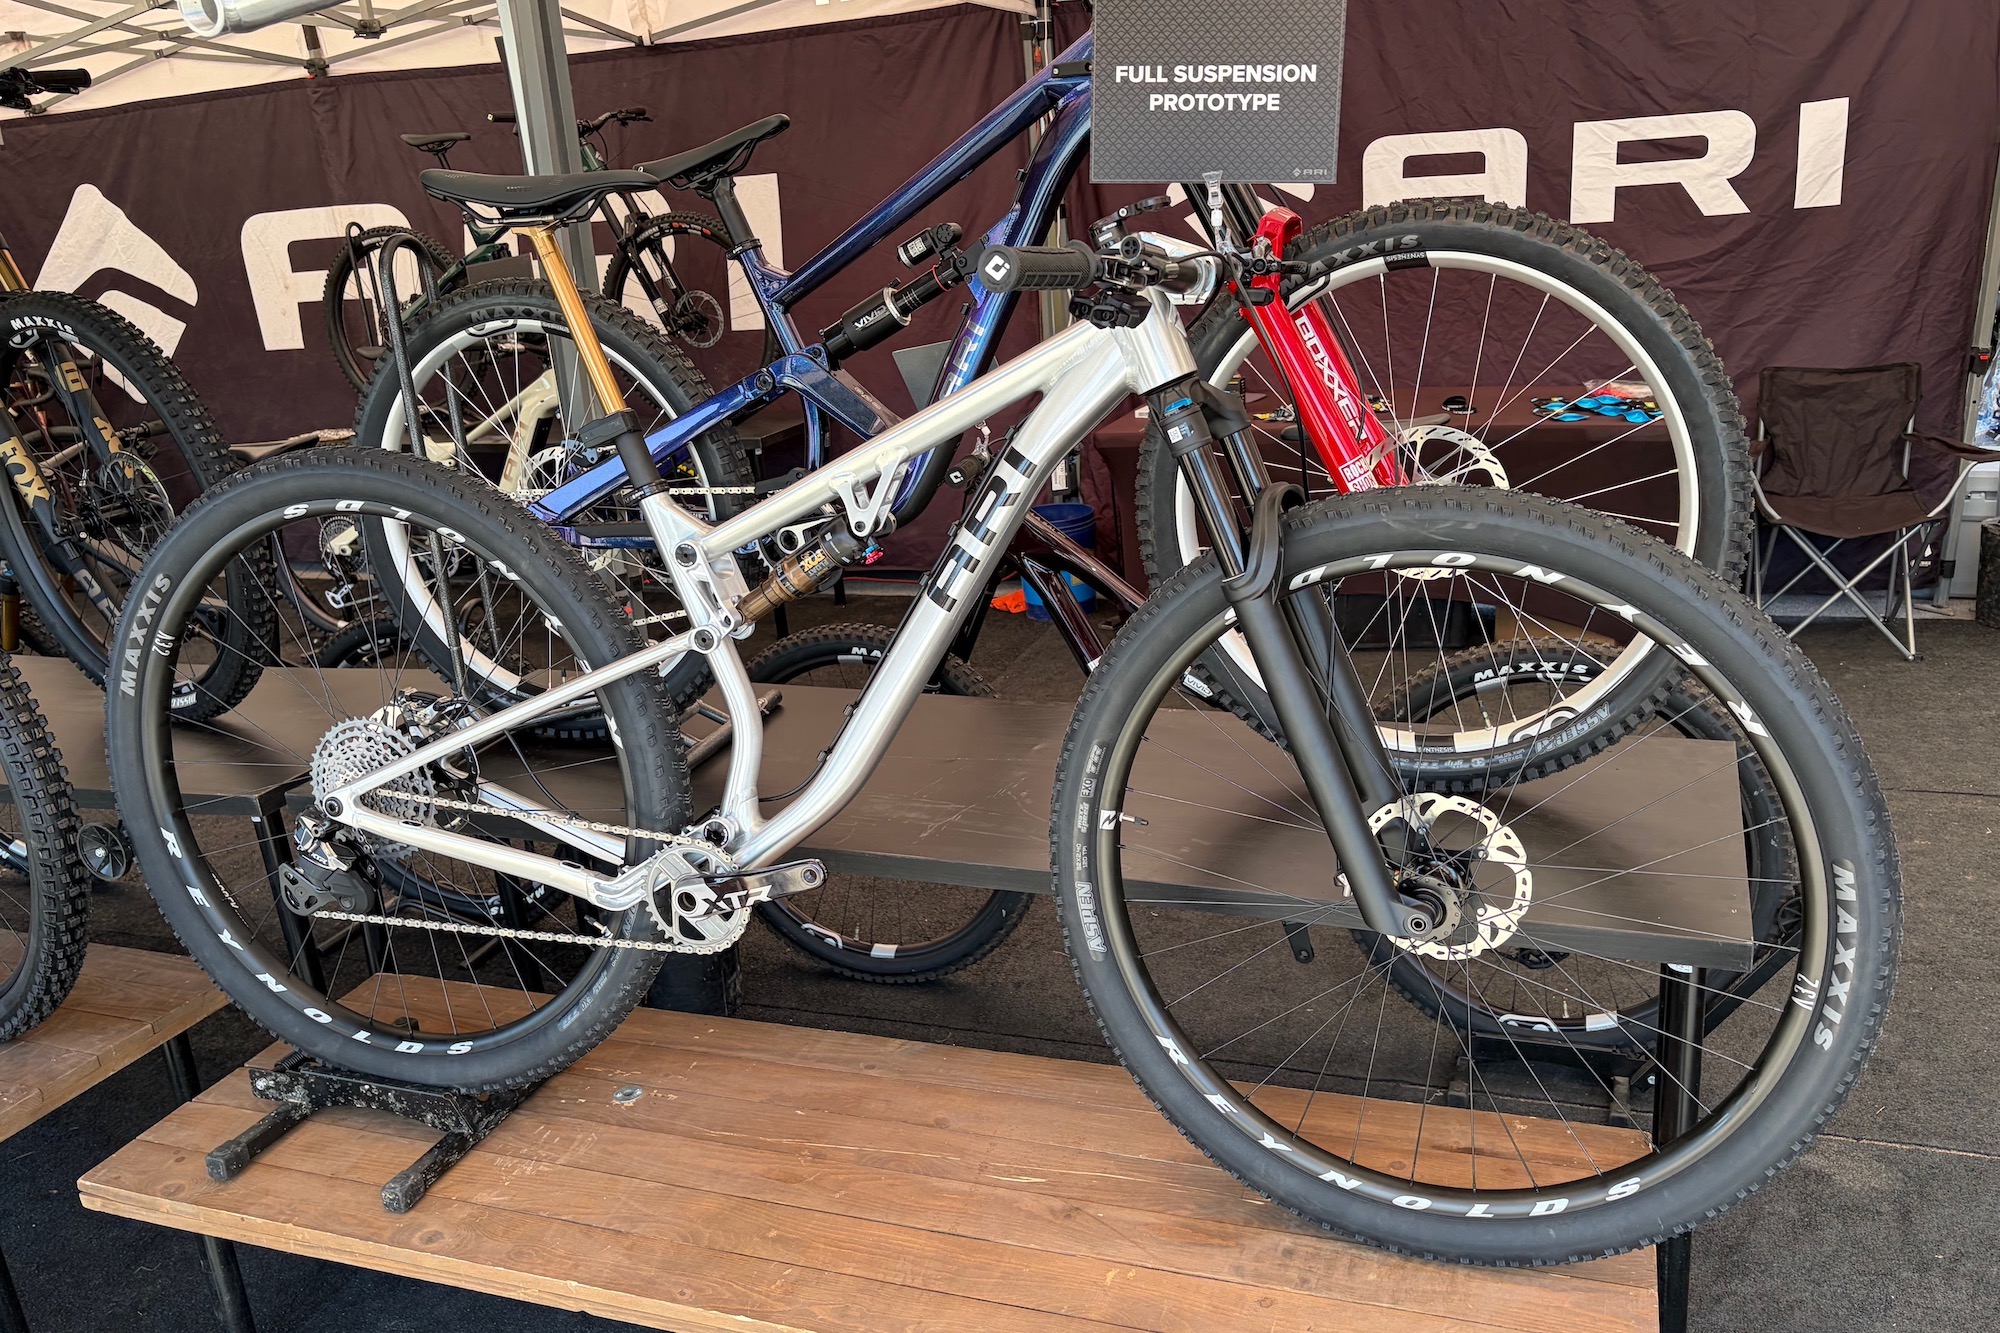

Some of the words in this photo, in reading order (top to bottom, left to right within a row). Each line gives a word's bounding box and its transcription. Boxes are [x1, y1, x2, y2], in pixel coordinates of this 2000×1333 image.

[1115, 65, 1168, 83] FULL
[1174, 64, 1318, 83] SUSPENSION
[1149, 93, 1281, 111] PROTOTYPE
[1303, 168, 1328, 176] ARI
[1362, 96, 1850, 225] ARI
[1280, 234, 1418, 294] MAXXIS
[1386, 250, 1425, 263] SYNTHESIS
[10, 315, 75, 335] MAXXIS
[471, 305, 566, 324] MAXXI
[853, 304, 888, 331] VIVID
[1295, 315, 1368, 441] BOXXER
[0, 435, 51, 509] FOX
[1342, 457, 1369, 481] ROCK
[926, 445, 1038, 612] ARI
[799, 549, 827, 573] FOX
[119, 573, 172, 698] MAXXIS
[1473, 661, 1589, 682] MAXXIS
[1187, 676, 1212, 696] VIVID
[1417, 746, 1454, 754] SYNTHESIS
[1081, 778, 1096, 798] EXO
[703, 884, 775, 915] XTR
[1075, 880, 1108, 953] ASPEN
[160, 826, 475, 1055] REYNOLDS
[1813, 863, 1858, 1051] MAXXIS
[1155, 1034, 1642, 1219] REYNOLDS
